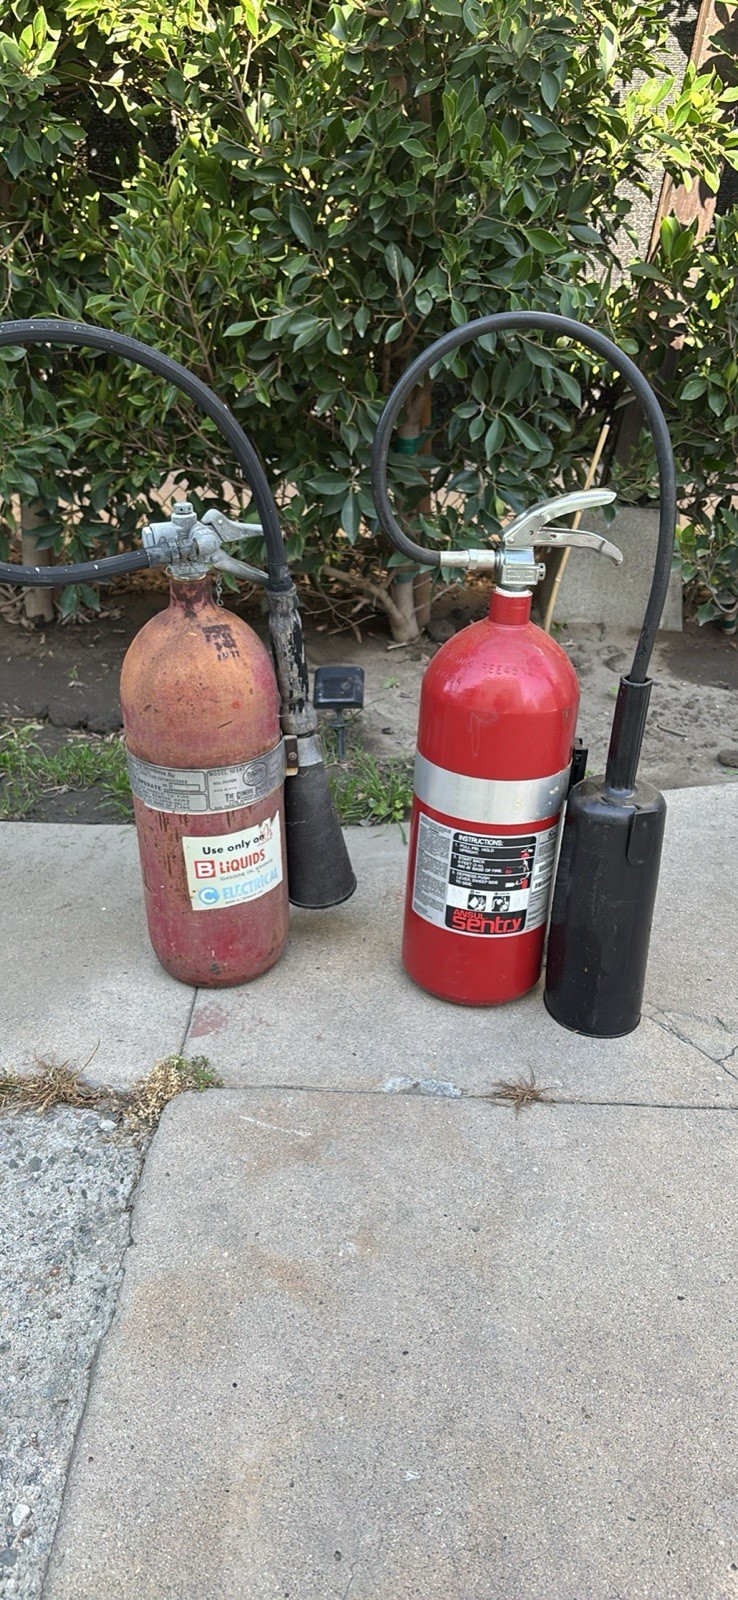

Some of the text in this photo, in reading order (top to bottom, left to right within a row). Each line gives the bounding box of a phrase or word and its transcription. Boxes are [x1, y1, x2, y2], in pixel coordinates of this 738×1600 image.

[202, 834, 265, 855] Use only on
[458, 834, 504, 846] INSTRUCTIONS:
[195, 861, 216, 878] B
[200, 888, 217, 904] C
[453, 909, 484, 920] ANSUL
